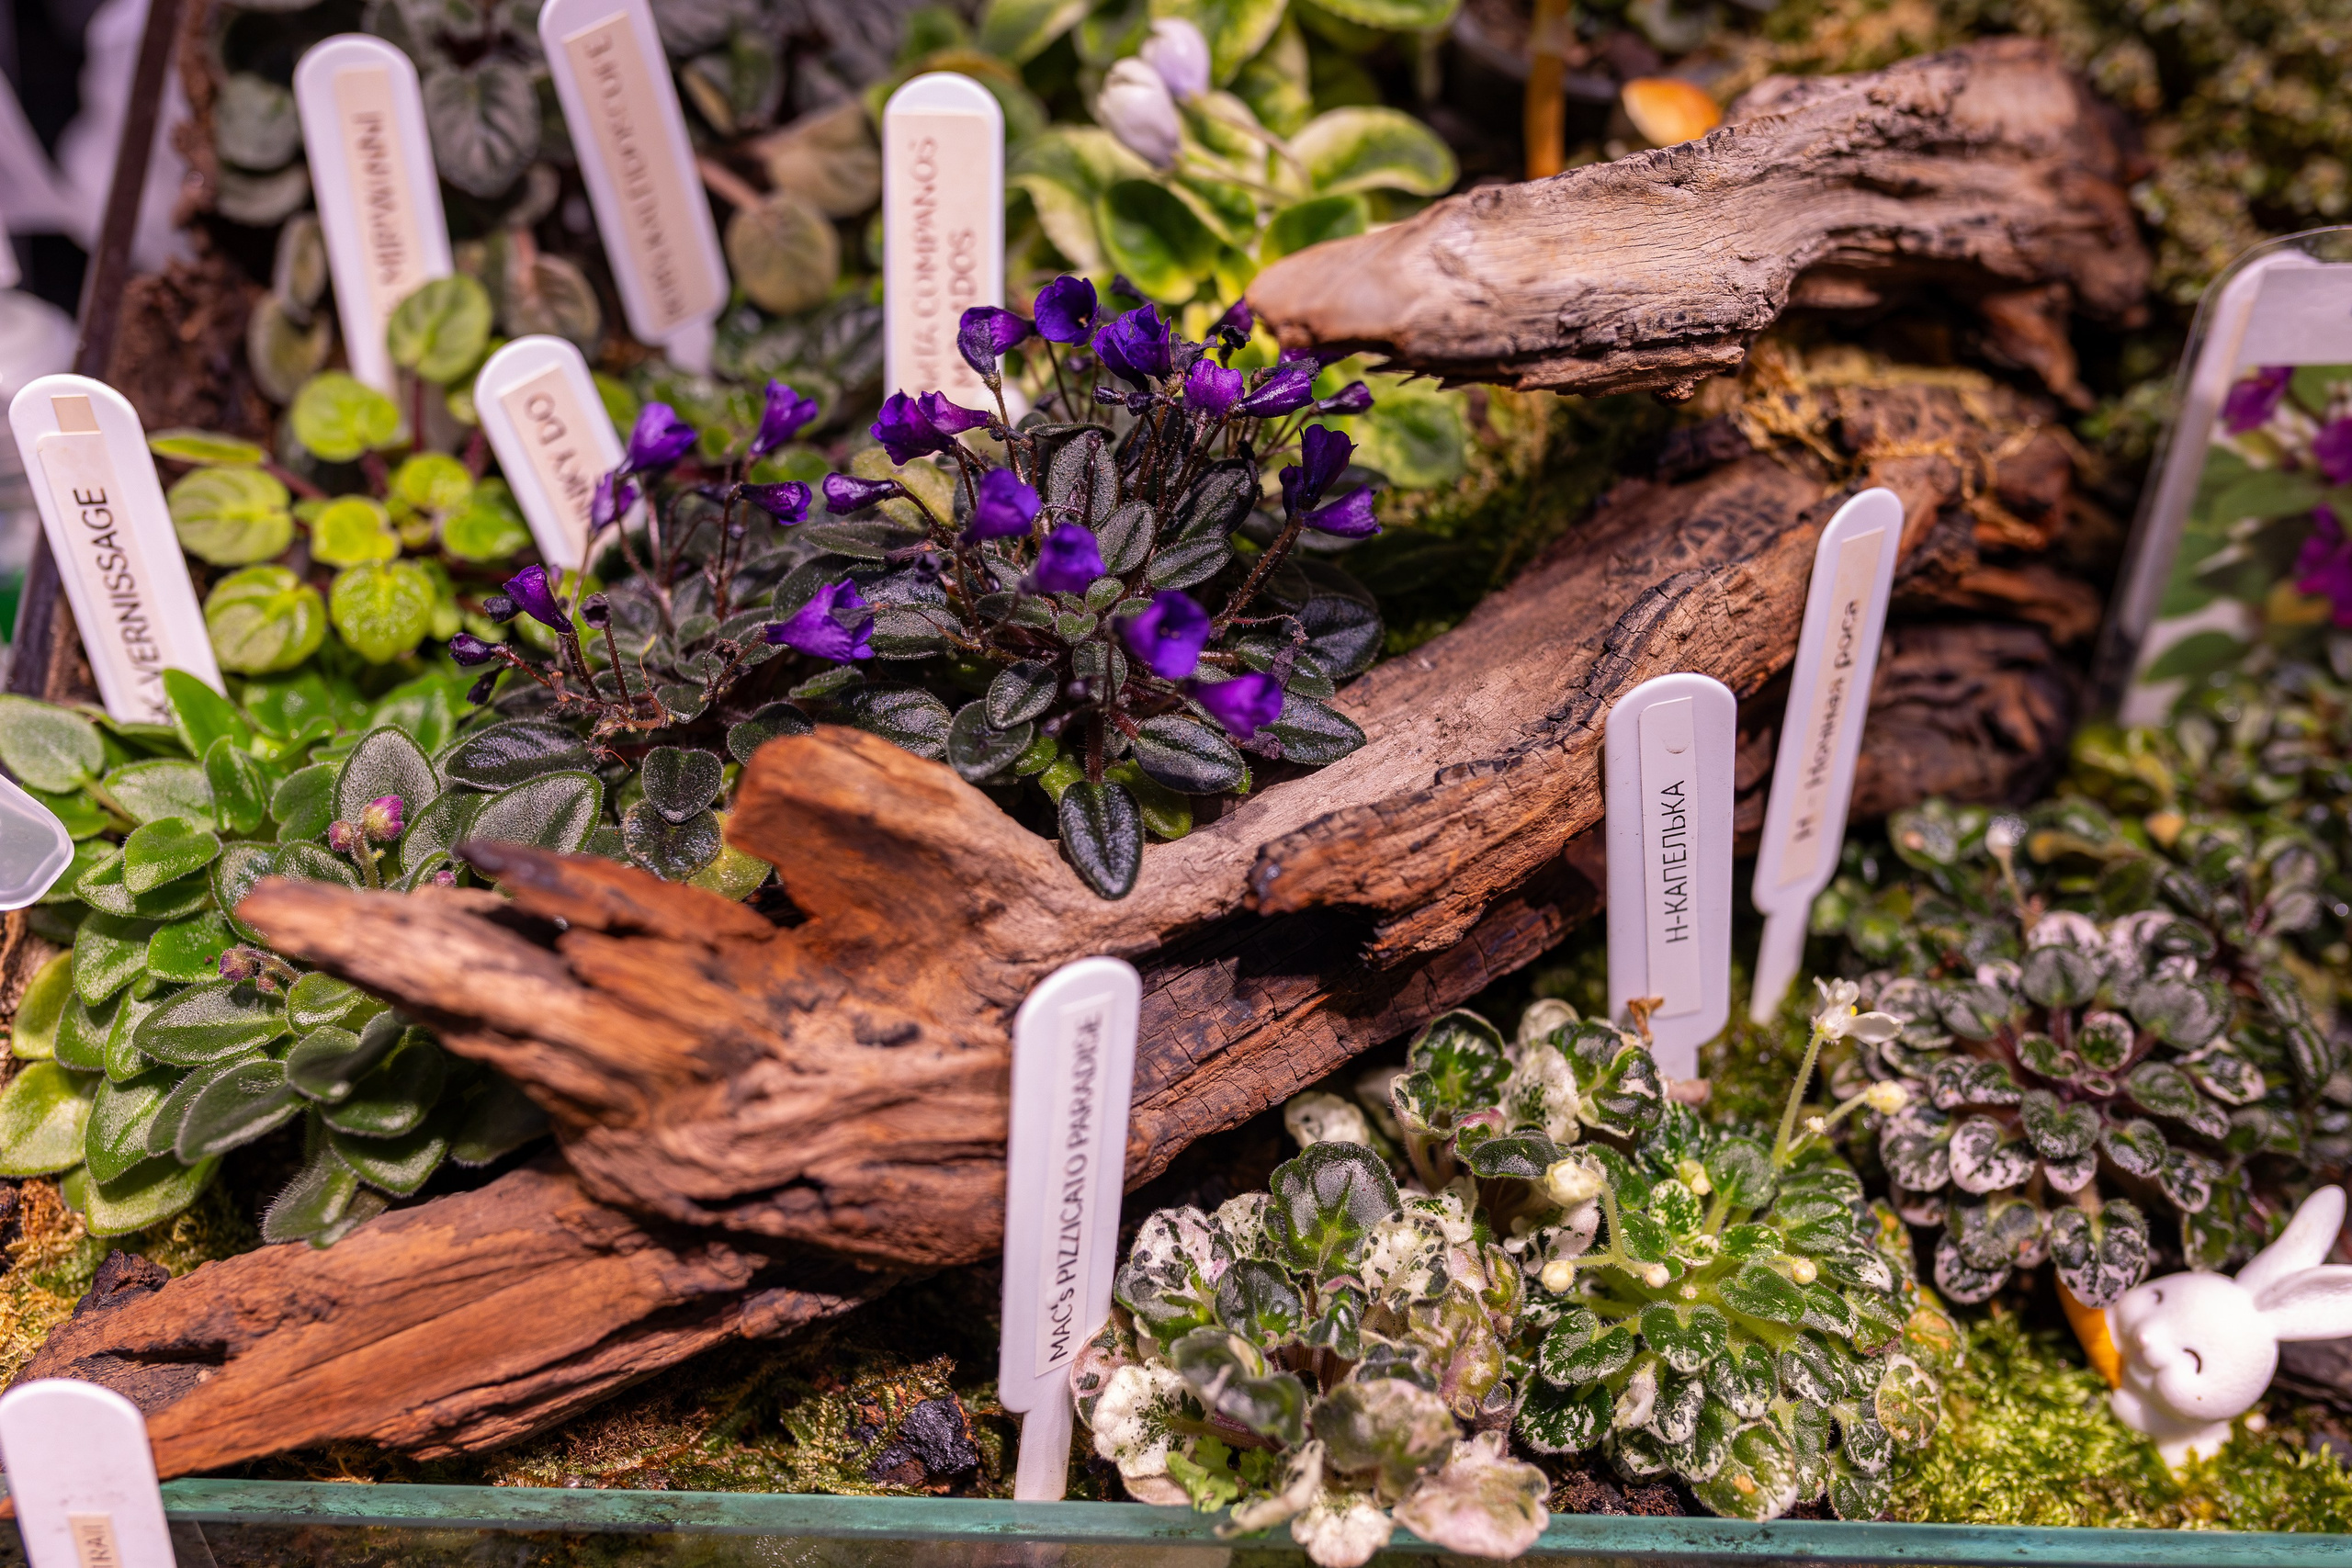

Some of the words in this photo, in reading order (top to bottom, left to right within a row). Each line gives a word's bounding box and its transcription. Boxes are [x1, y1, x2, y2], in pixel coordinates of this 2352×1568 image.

[1832, 599, 1860, 670] роса
[1660, 780, 1689, 944] Н-КАПЕЛЬКА
[1064, 1010, 1103, 1152] PARADISE
[1054, 1153, 1089, 1286] PIZZICATO
